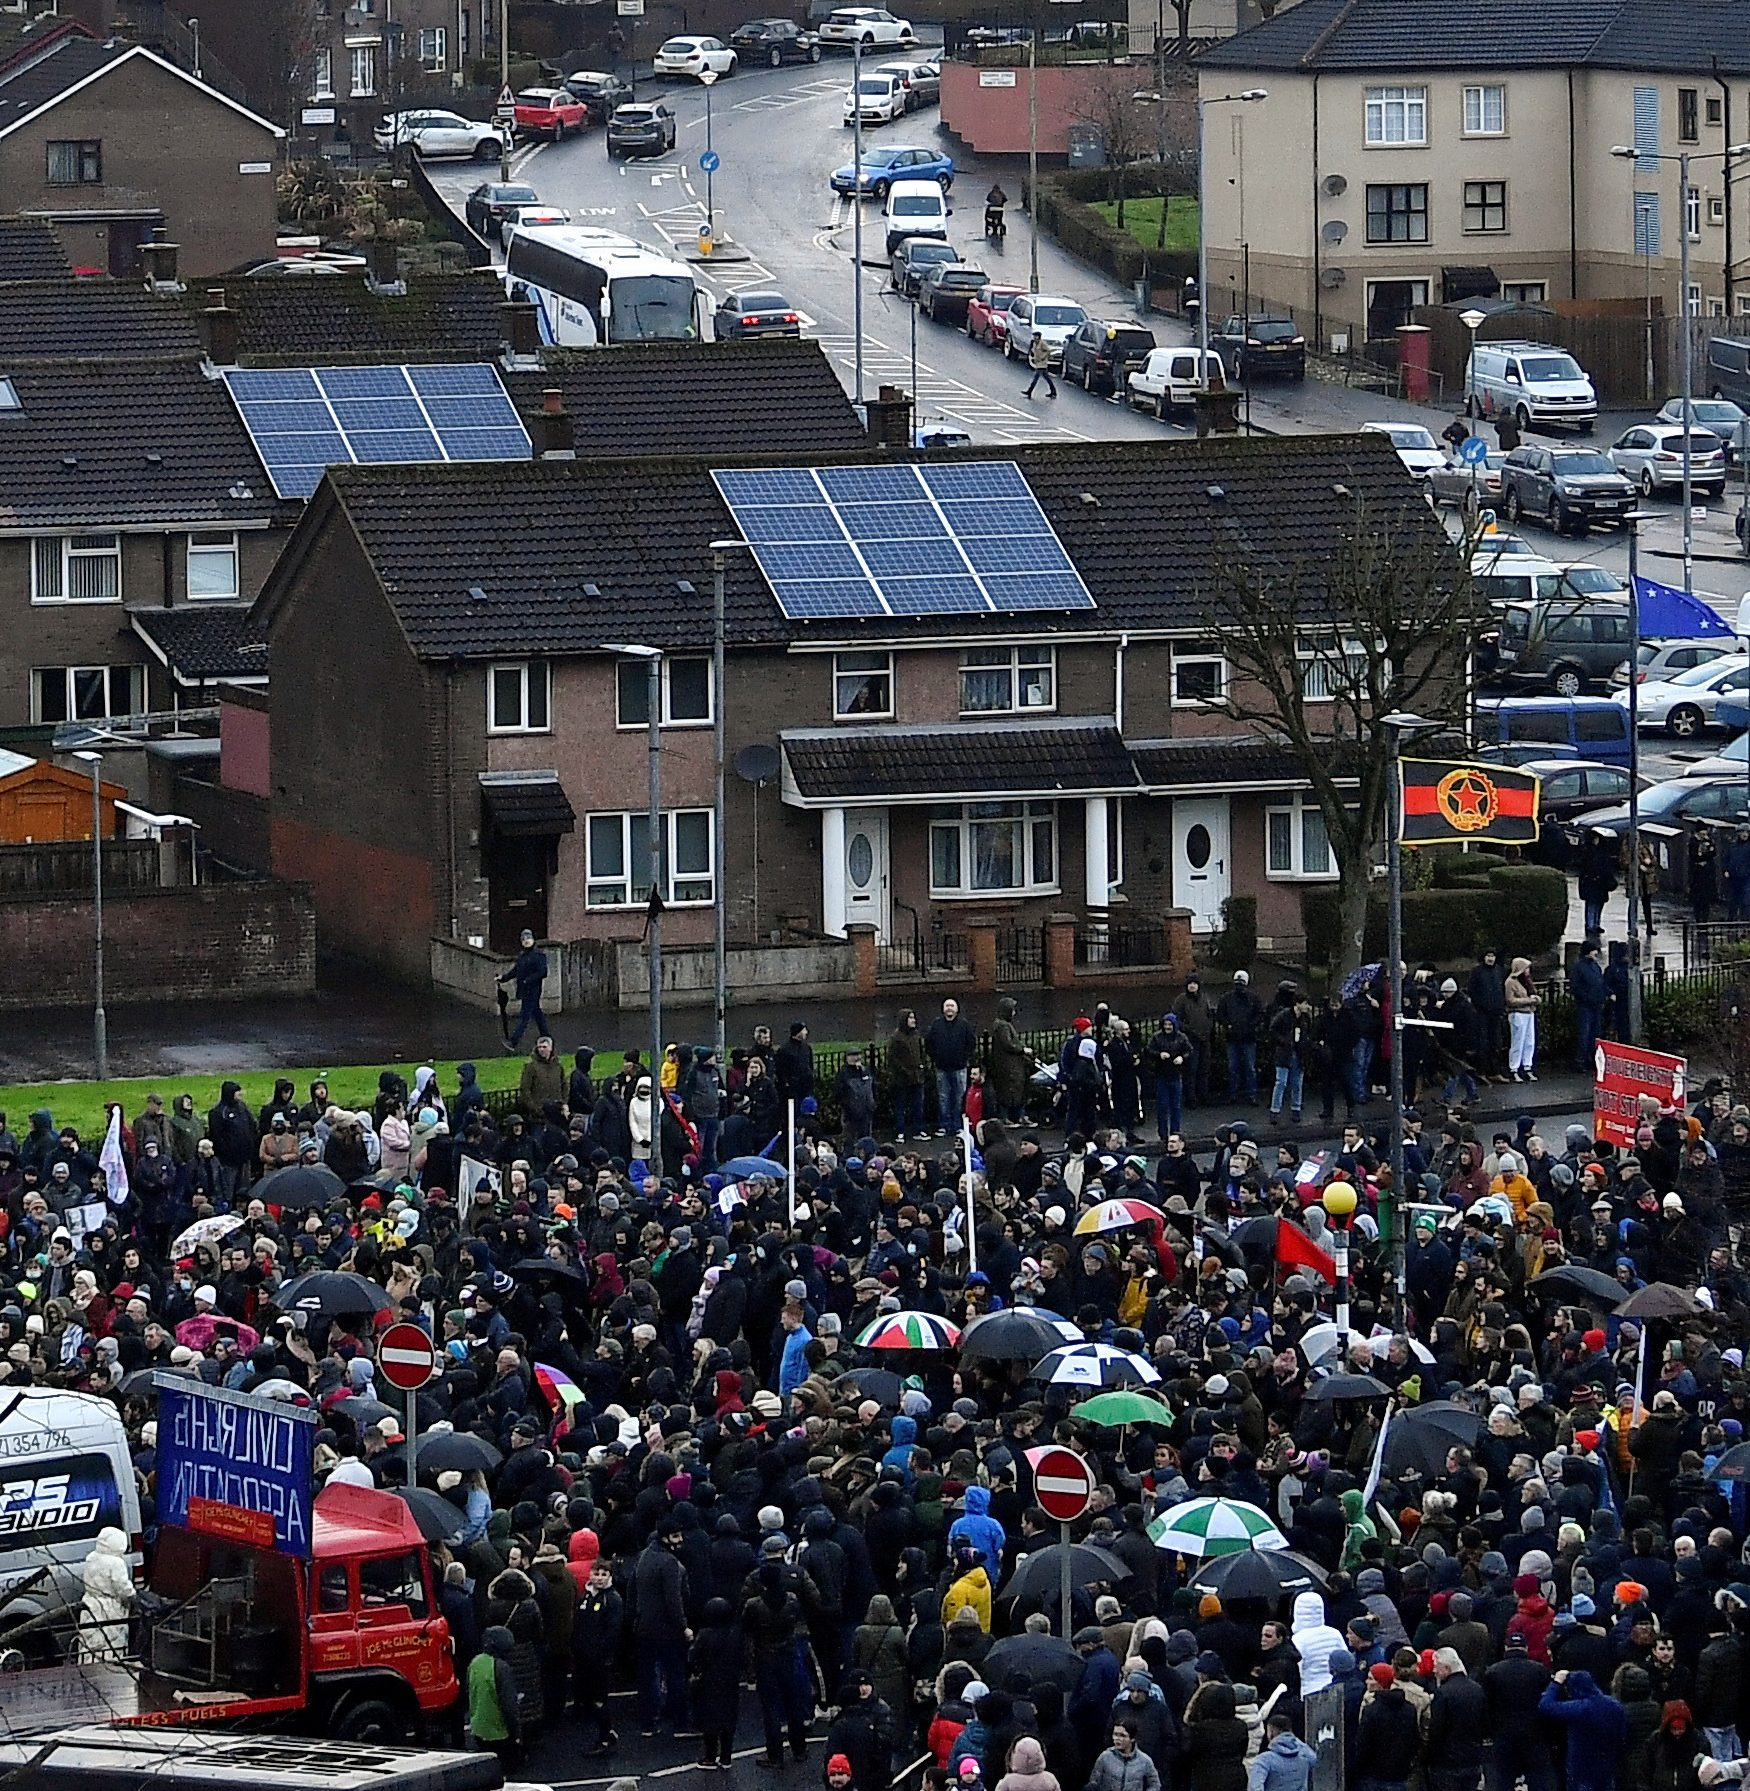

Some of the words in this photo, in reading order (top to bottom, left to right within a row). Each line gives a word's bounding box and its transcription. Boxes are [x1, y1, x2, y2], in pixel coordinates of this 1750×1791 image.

[13, 1434, 40, 1454] 354
[43, 1429, 71, 1450] 796
[181, 1706, 227, 1721] FUELS
